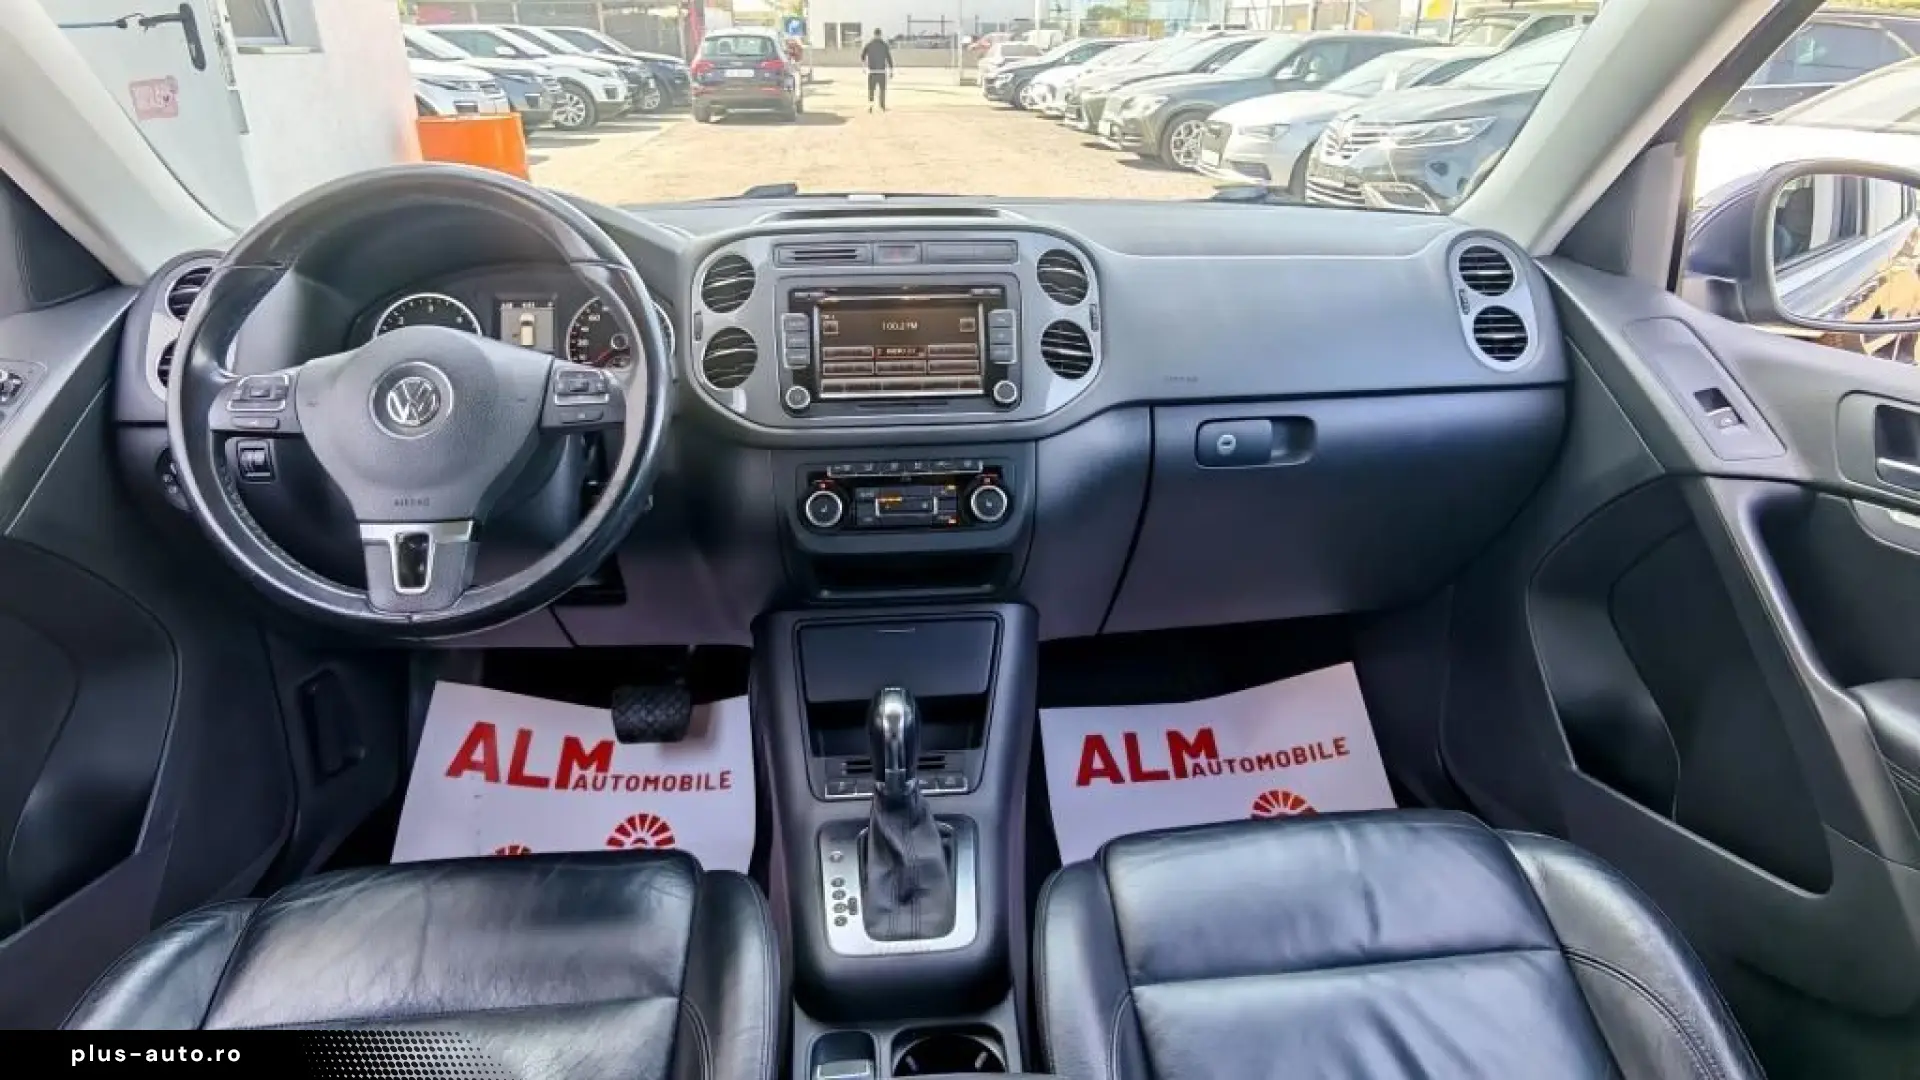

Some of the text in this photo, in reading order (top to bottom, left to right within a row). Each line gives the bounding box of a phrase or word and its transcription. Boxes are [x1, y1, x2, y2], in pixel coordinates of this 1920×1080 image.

[444, 720, 616, 790] ALM
[571, 770, 732, 792] AUTOMOBILE
[1076, 726, 1220, 787] ALM
[1190, 736, 1351, 779] AUTOMOBILE
